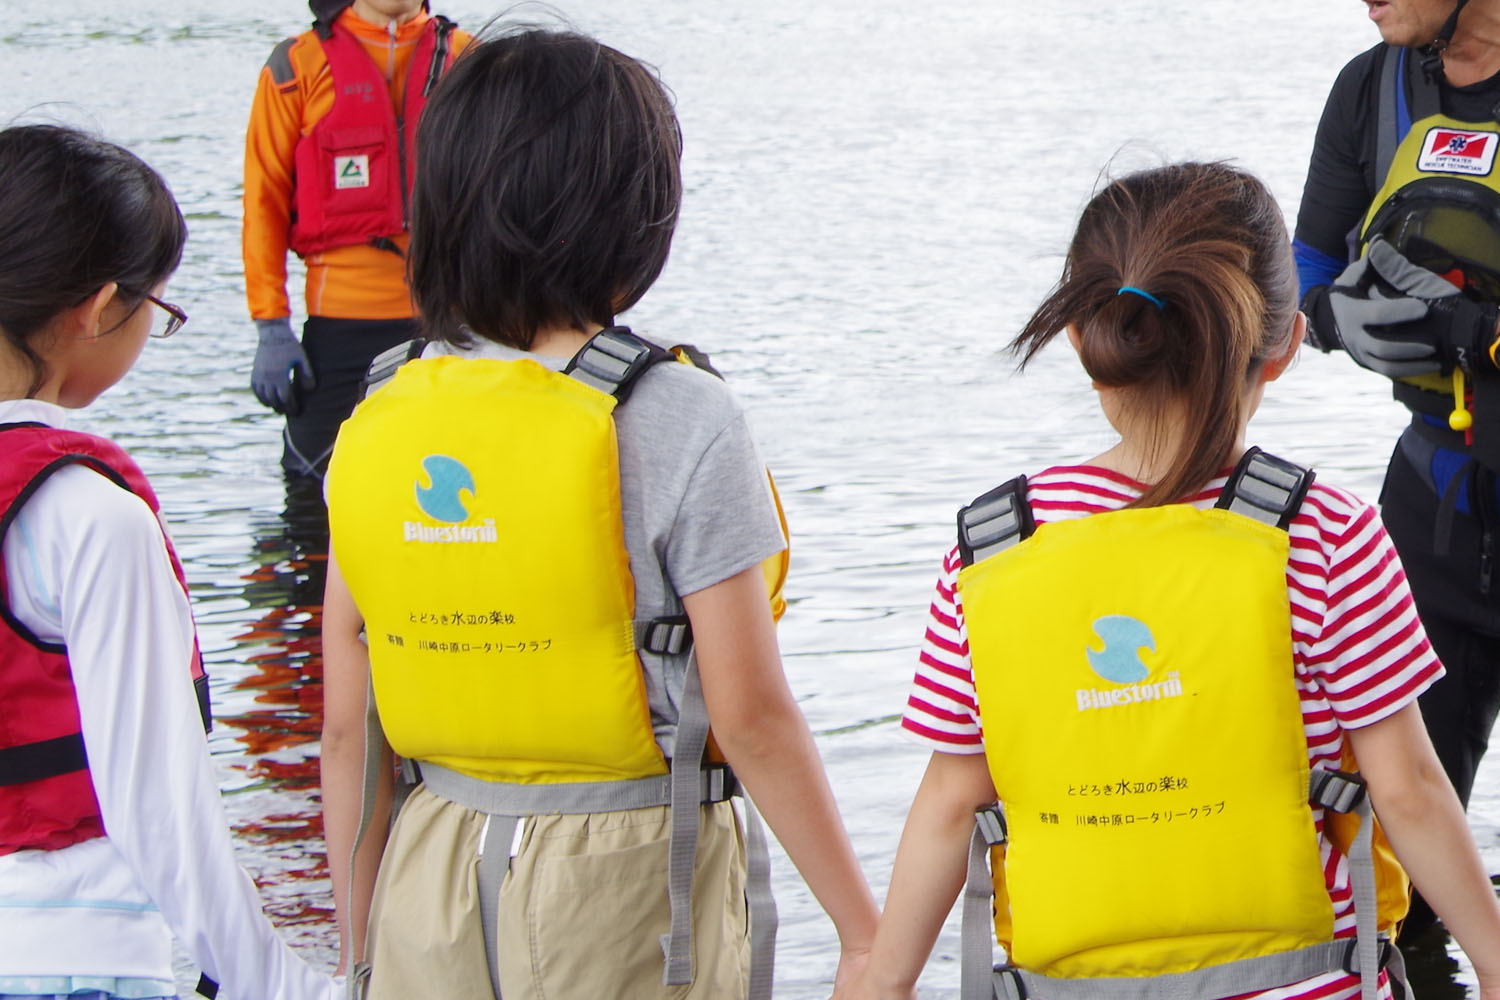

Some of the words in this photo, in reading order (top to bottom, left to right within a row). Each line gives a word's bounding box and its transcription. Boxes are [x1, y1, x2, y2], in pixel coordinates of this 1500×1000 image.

[409, 610, 516, 626] とどろき水辺の楽校
[419, 638, 552, 653] 川崎中原ロータリークラブ
[1076, 679, 1183, 712] Bluestorm
[1067, 775, 1189, 796] とどろき水辺の楽校
[1076, 801, 1225, 827] 川崎中原ロータリークラブ
